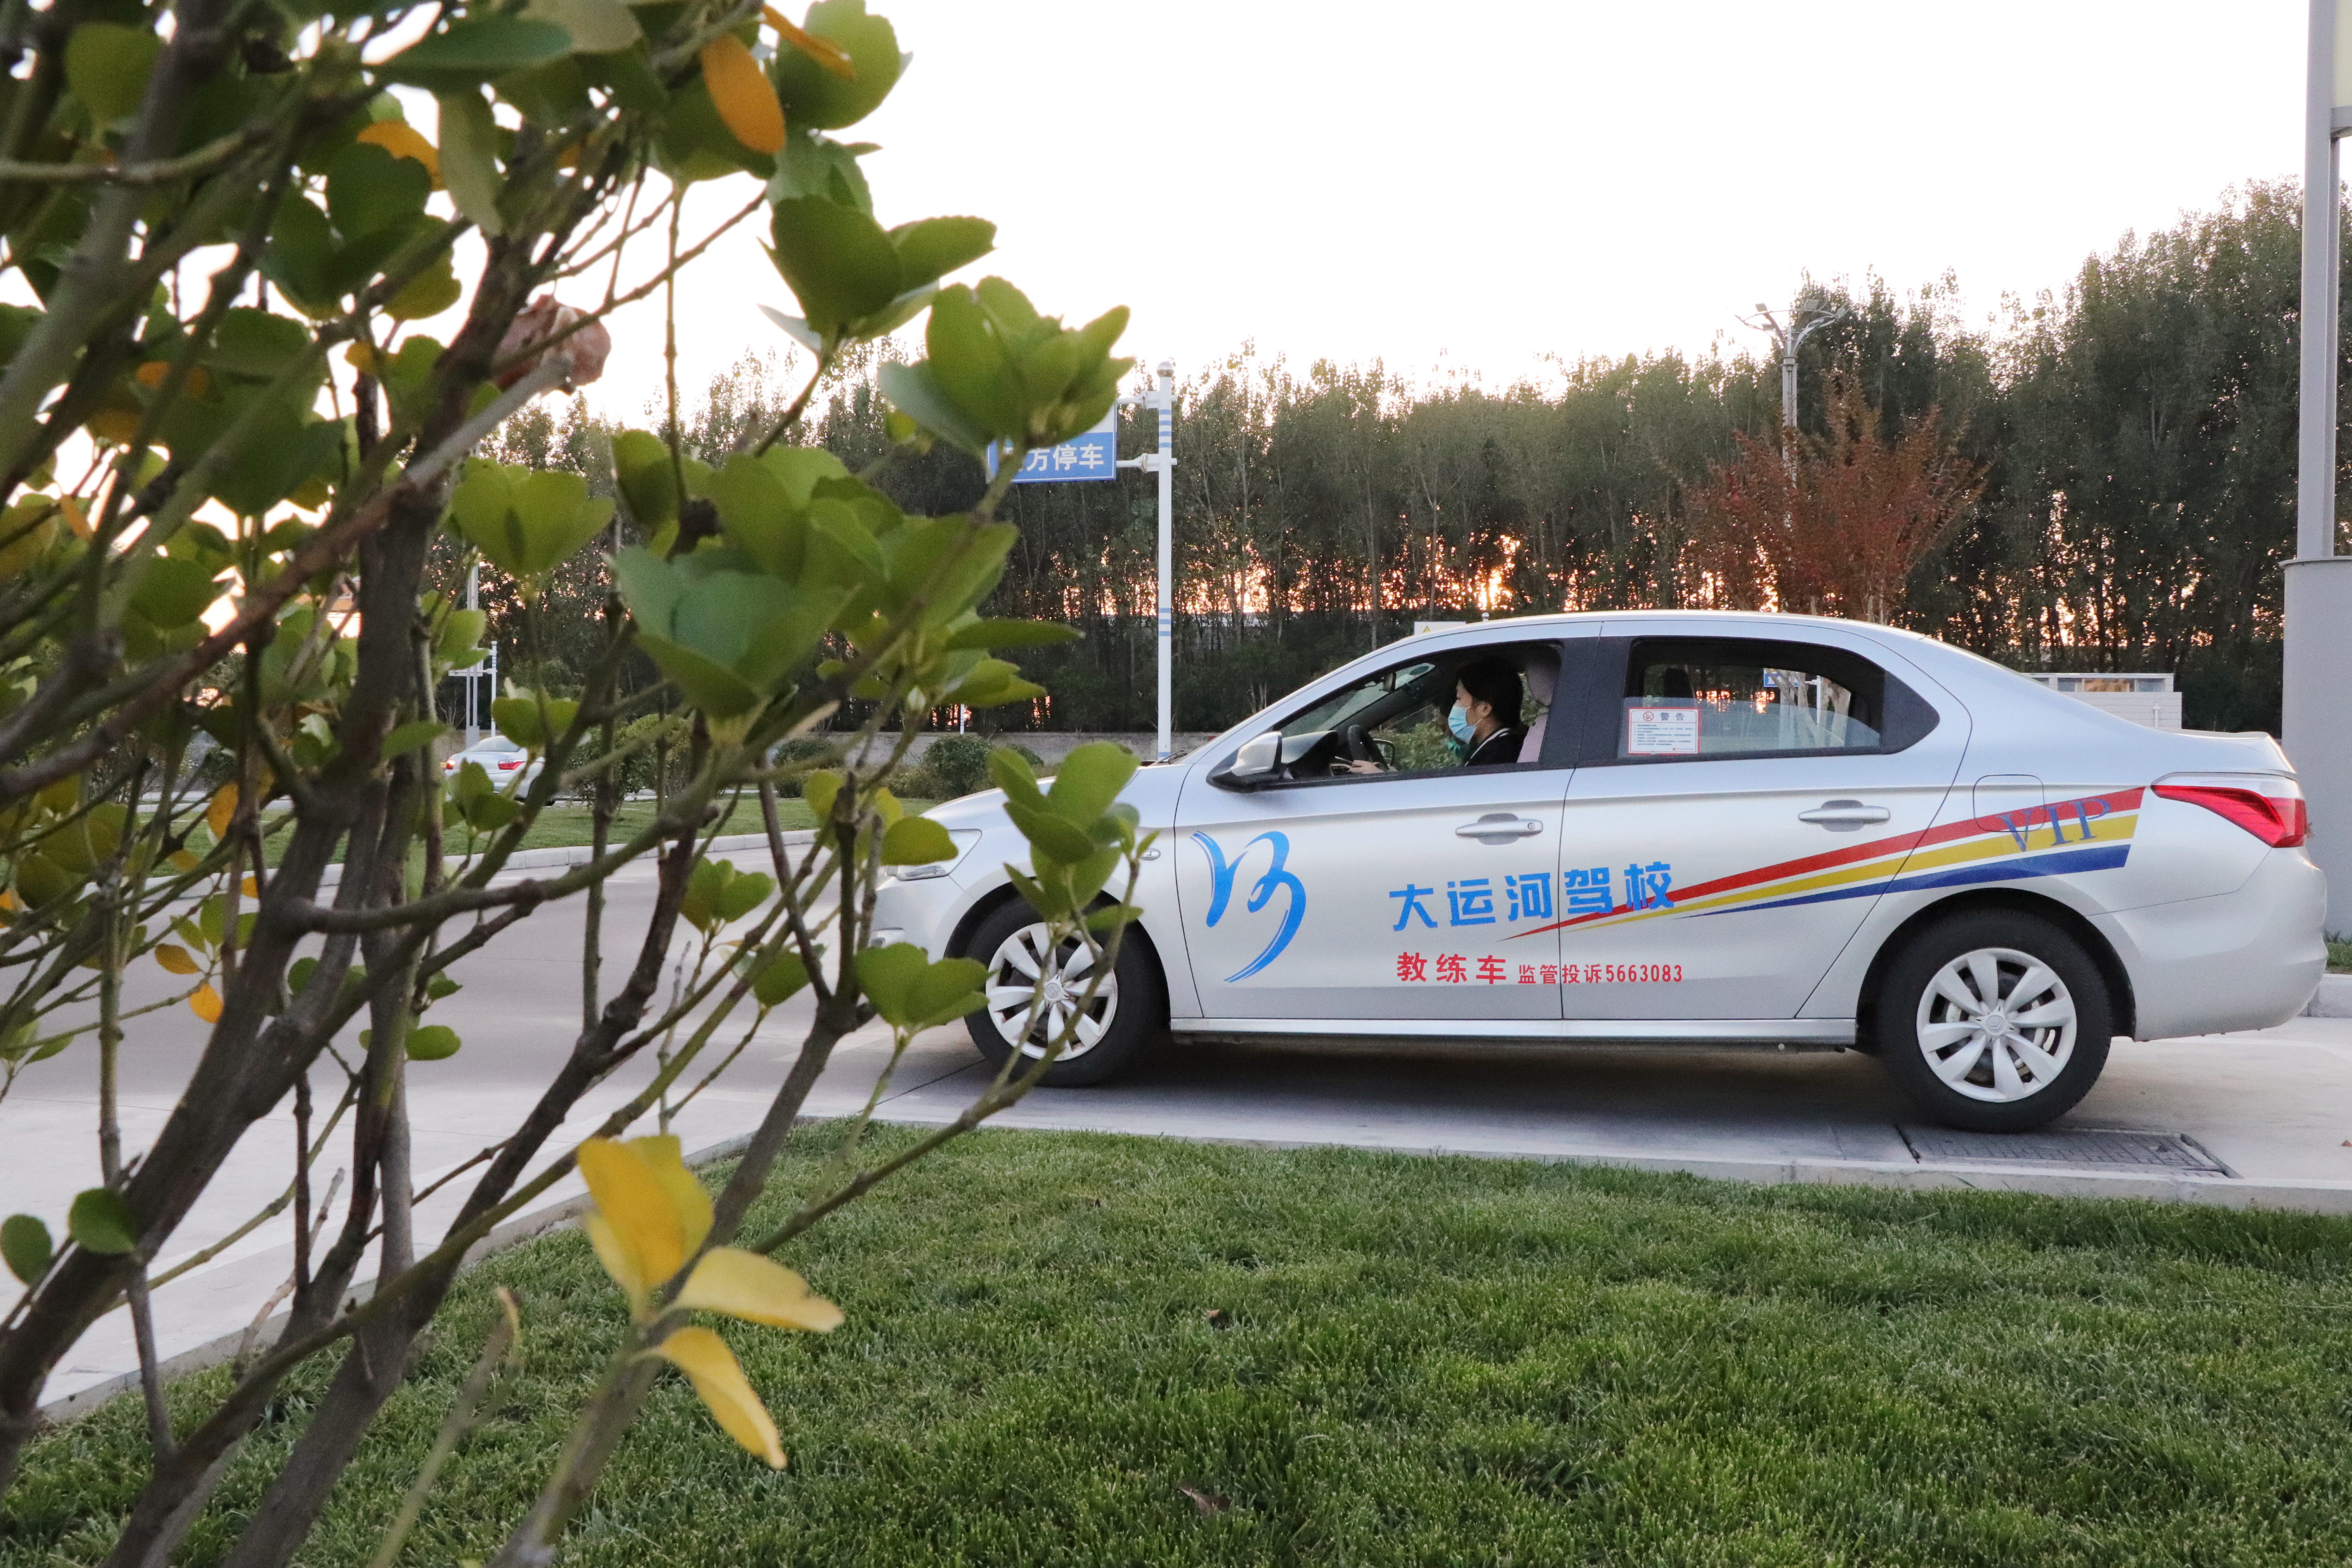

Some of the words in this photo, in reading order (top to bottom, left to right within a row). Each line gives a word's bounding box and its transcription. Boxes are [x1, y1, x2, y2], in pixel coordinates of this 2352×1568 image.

[1003, 443, 1104, 472] 方停车
[1660, 712, 1685, 721] 警告
[1995, 798, 2112, 852] VIP
[1389, 861, 1675, 931] 大运河驾校
[1397, 952, 1507, 985] 教练车
[1518, 963, 1683, 984] 监管投诉5663083
